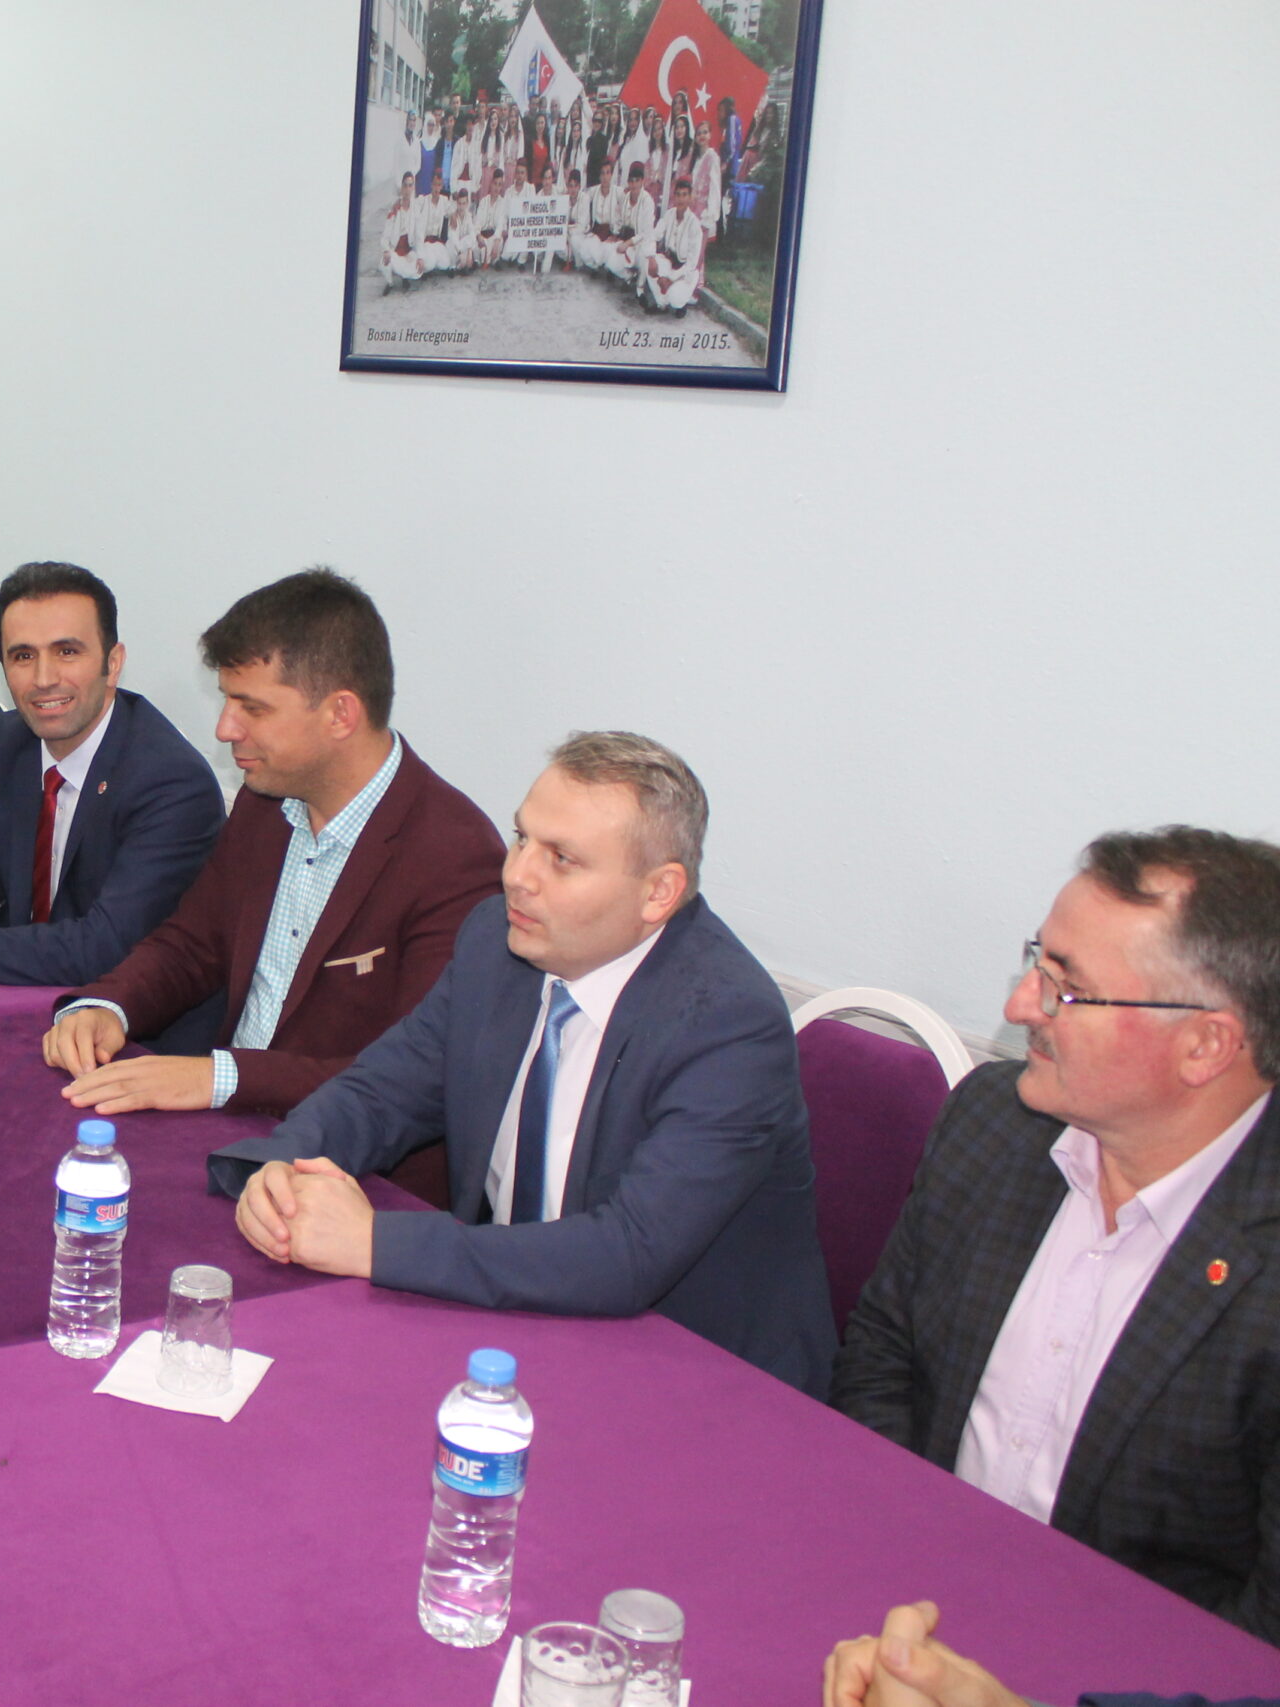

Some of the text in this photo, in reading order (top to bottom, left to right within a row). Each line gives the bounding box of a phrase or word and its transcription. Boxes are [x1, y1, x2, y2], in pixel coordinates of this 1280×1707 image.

[367, 328, 396, 342] Bosna
[405, 328, 469, 346] Hercegovina
[632, 332, 652, 348] 23.
[659, 333, 686, 352] maj
[691, 333, 731, 350] 2015.
